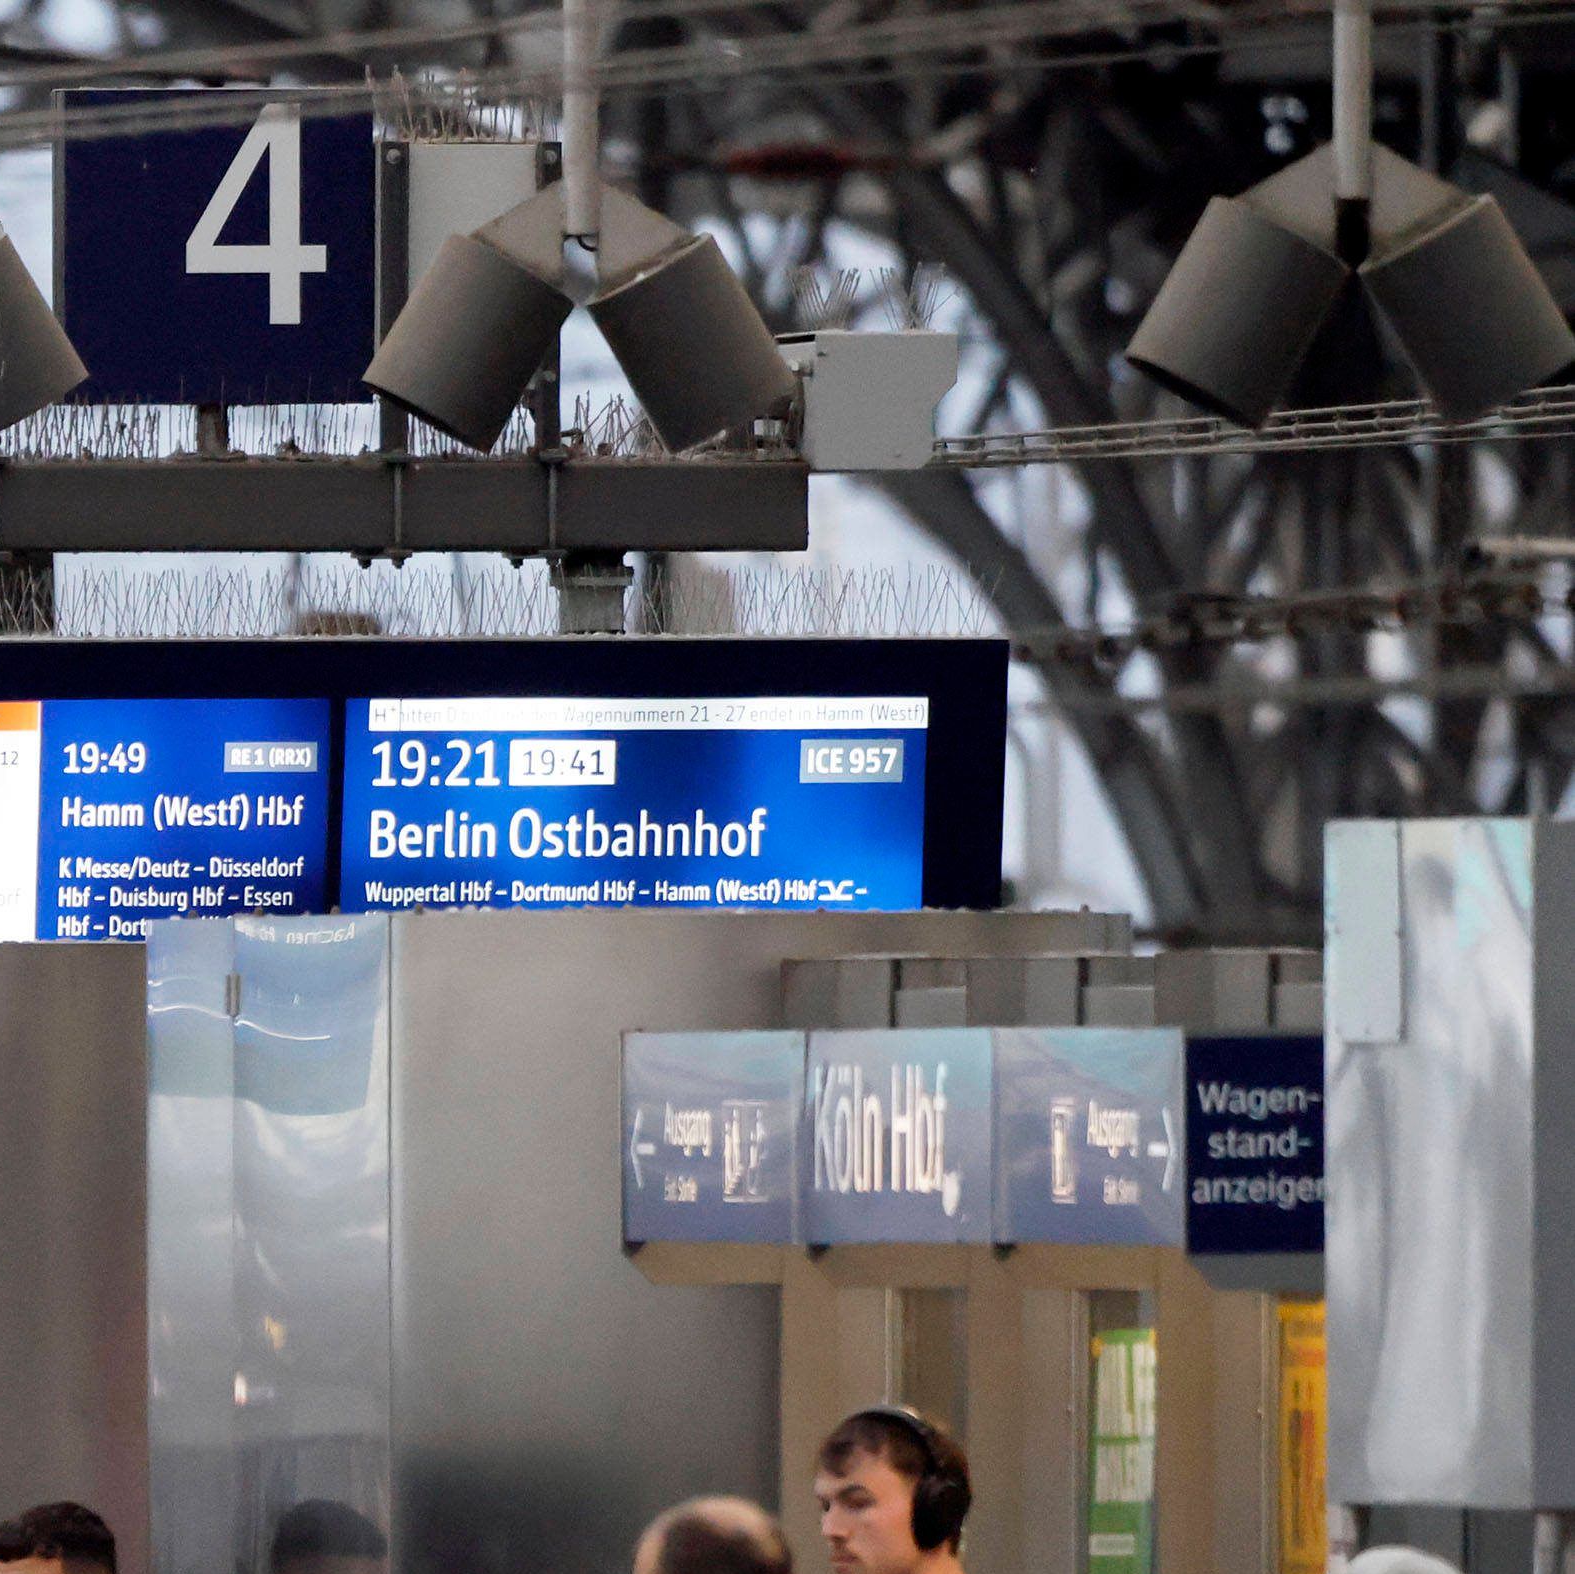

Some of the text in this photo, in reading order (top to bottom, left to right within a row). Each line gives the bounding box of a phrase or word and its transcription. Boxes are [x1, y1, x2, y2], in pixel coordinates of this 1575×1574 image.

[185, 102, 327, 325] 4
[563, 706, 684, 727] Wagennummern
[690, 706, 710, 722] 21
[725, 706, 746, 722] 27
[816, 706, 864, 722] Hamm
[869, 704, 926, 724] (Westf)
[0, 750, 19, 765] 12
[64, 742, 146, 773] 19:49
[230, 747, 312, 768] RE 1 (RRX)
[372, 740, 500, 786] 19:21
[521, 748, 605, 776] 19:41
[807, 747, 898, 774] ICE 957
[62, 794, 304, 831] Hamm (Westf) Hbf
[370, 808, 766, 858] Berlin Ostbahnhof
[59, 856, 304, 880] K Messe/Deutz Düsseldorf
[58, 886, 292, 911] Hbf Duisburg Hbf Essen
[365, 879, 819, 908] Wuppertal Hbf Dortmund Hbf Hamm (Westf) Hbf
[57, 915, 147, 937] Hbf Dort
[1197, 1080, 1321, 1121] Wagen-
[814, 1061, 948, 1194] Köln Hbf
[1207, 1125, 1314, 1160] stand-
